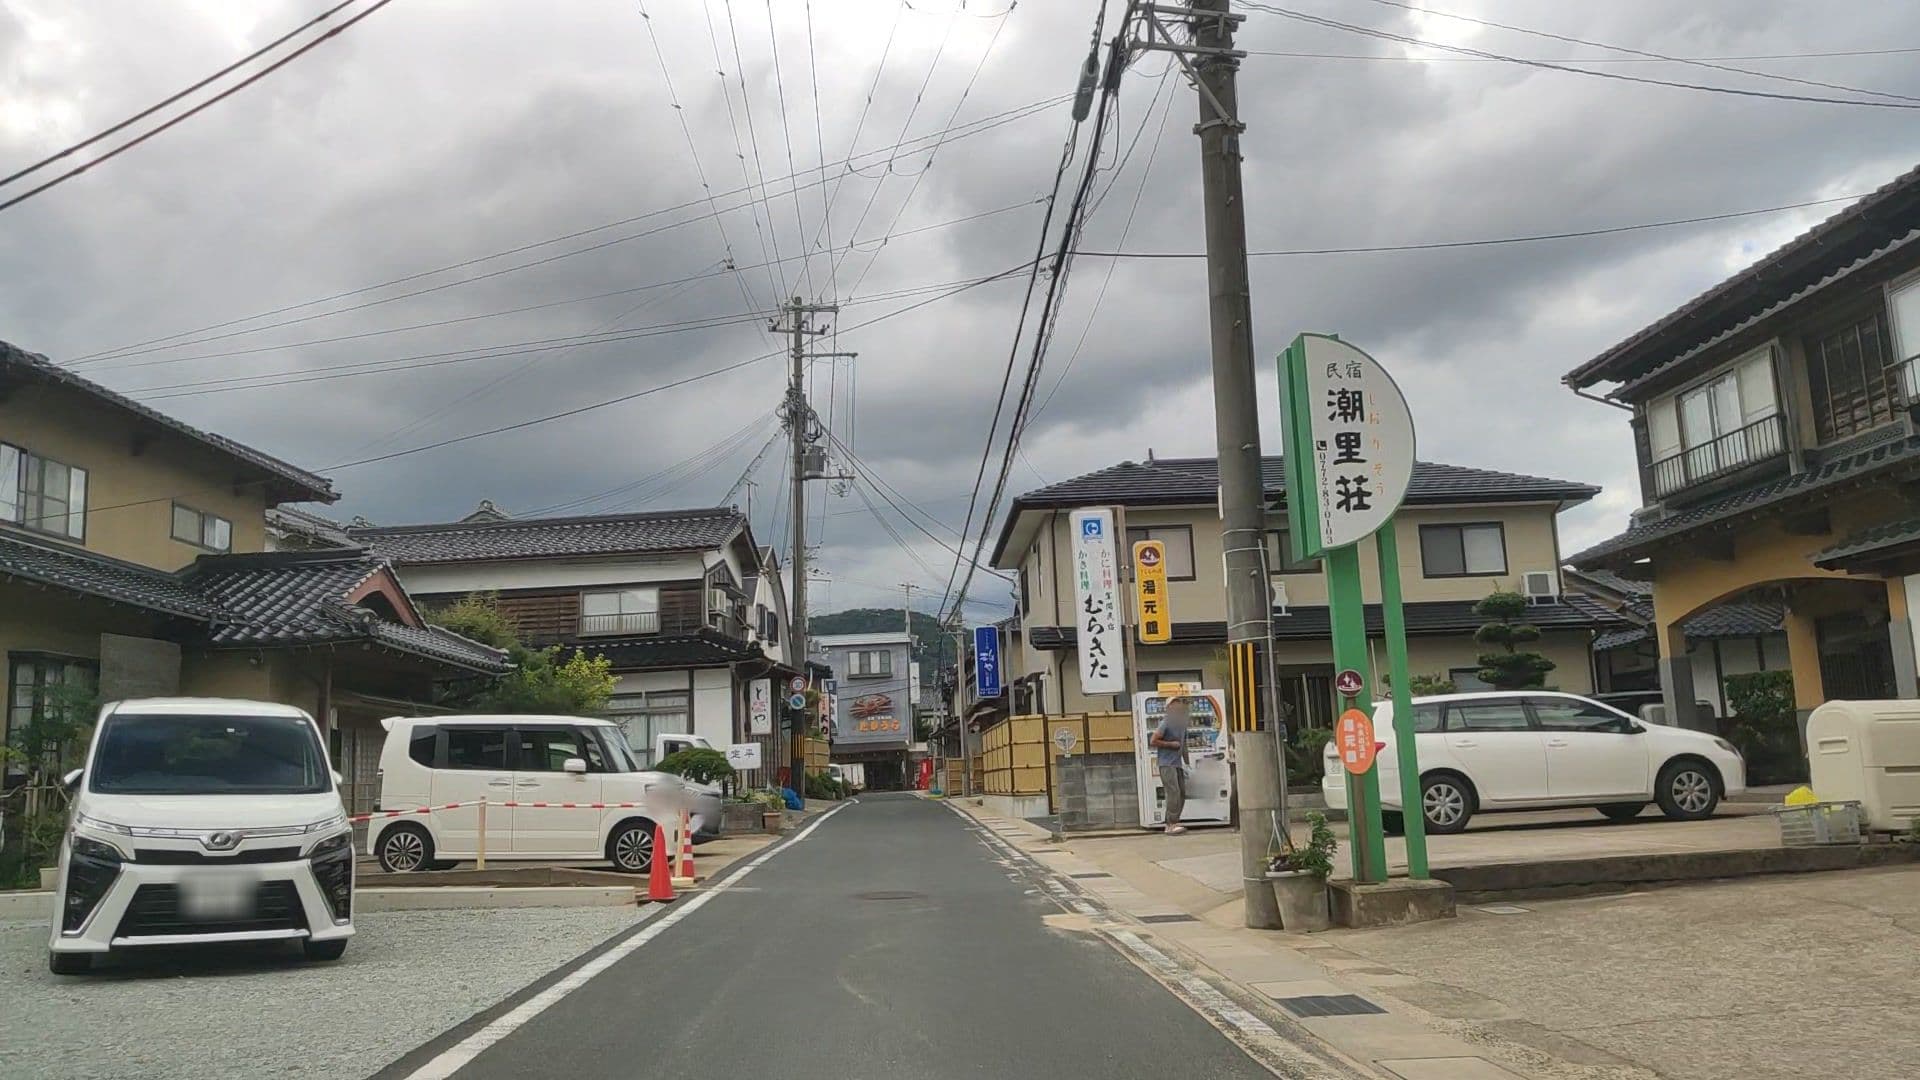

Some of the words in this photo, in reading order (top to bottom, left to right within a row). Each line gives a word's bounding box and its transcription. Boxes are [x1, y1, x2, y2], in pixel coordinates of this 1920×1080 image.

[1326, 361, 1362, 379] 民宿
[1327, 387, 1373, 513] 潮里荘
[1084, 594, 1109, 678] むらきた
